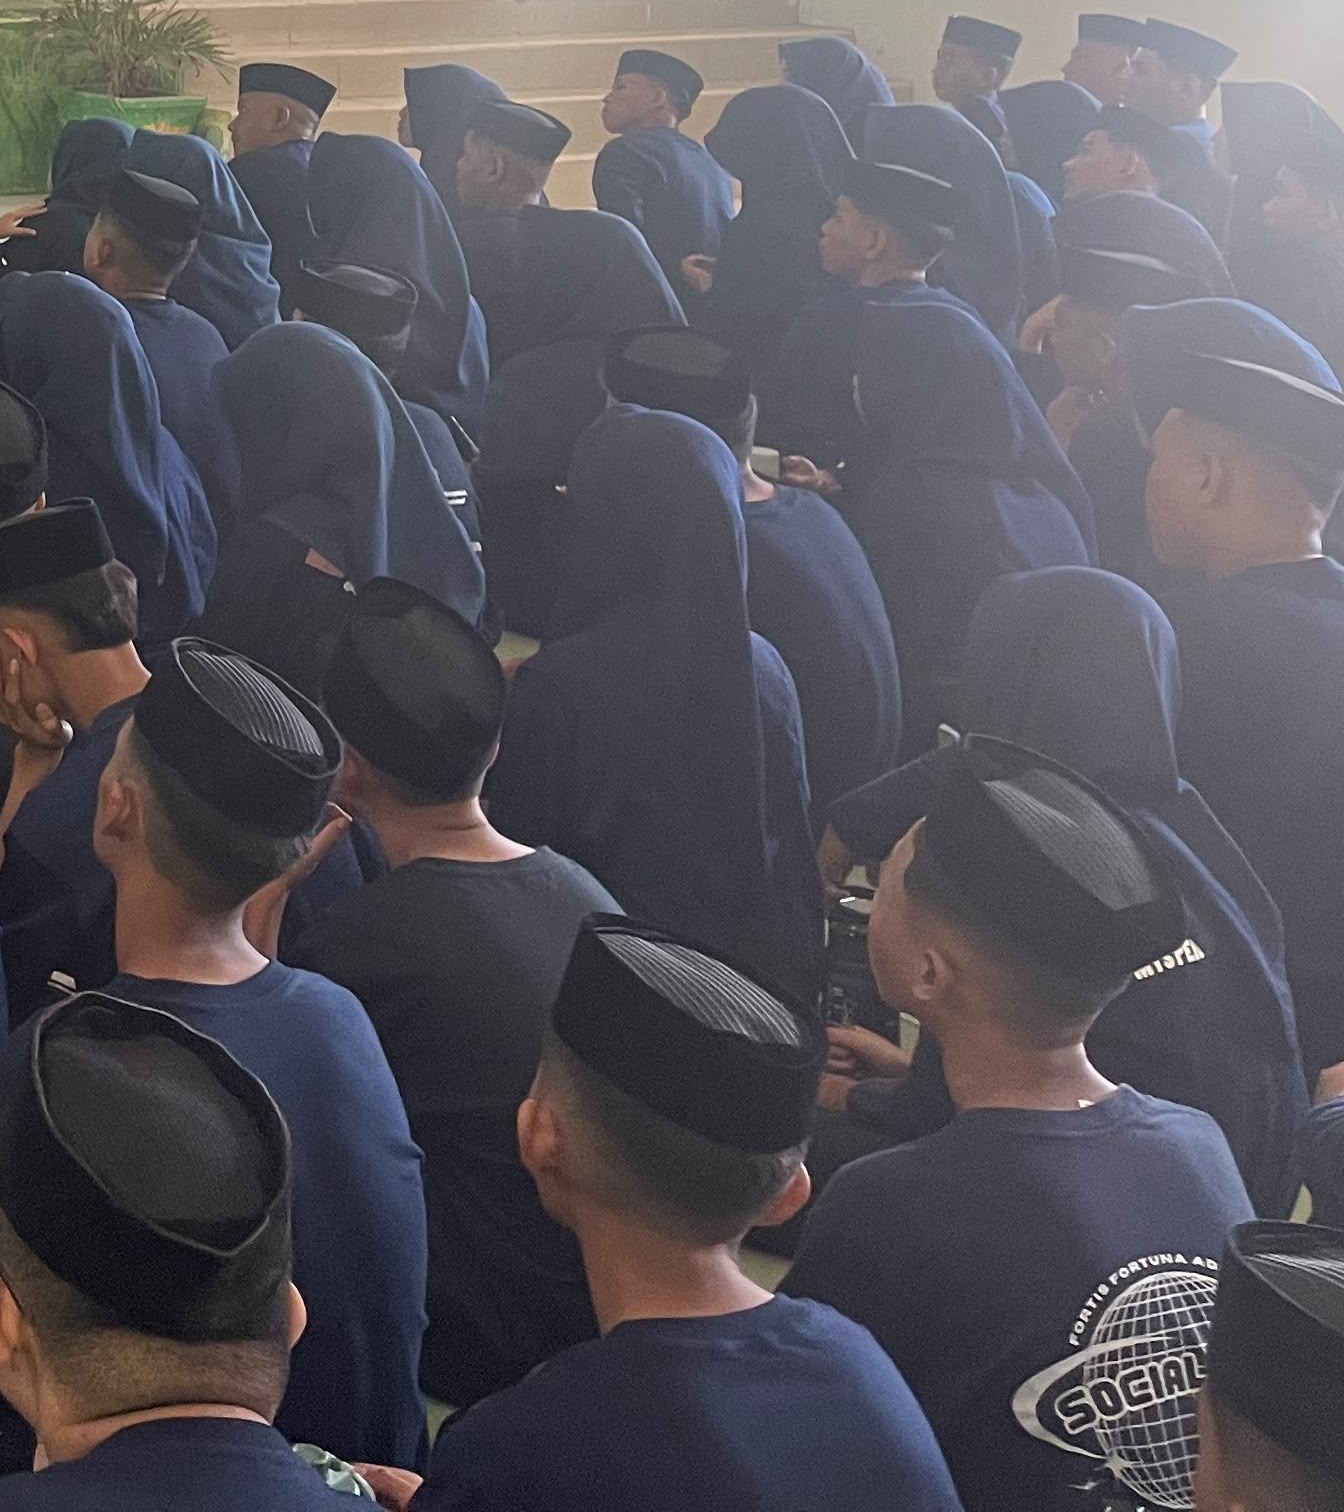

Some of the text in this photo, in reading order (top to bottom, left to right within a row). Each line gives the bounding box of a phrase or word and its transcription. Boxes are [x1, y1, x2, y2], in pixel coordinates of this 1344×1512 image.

[1068, 1283, 1110, 1347] FORTIS
[1108, 1252, 1187, 1286] FORTUNA
[1054, 1351, 1207, 1435] SOCIAL
